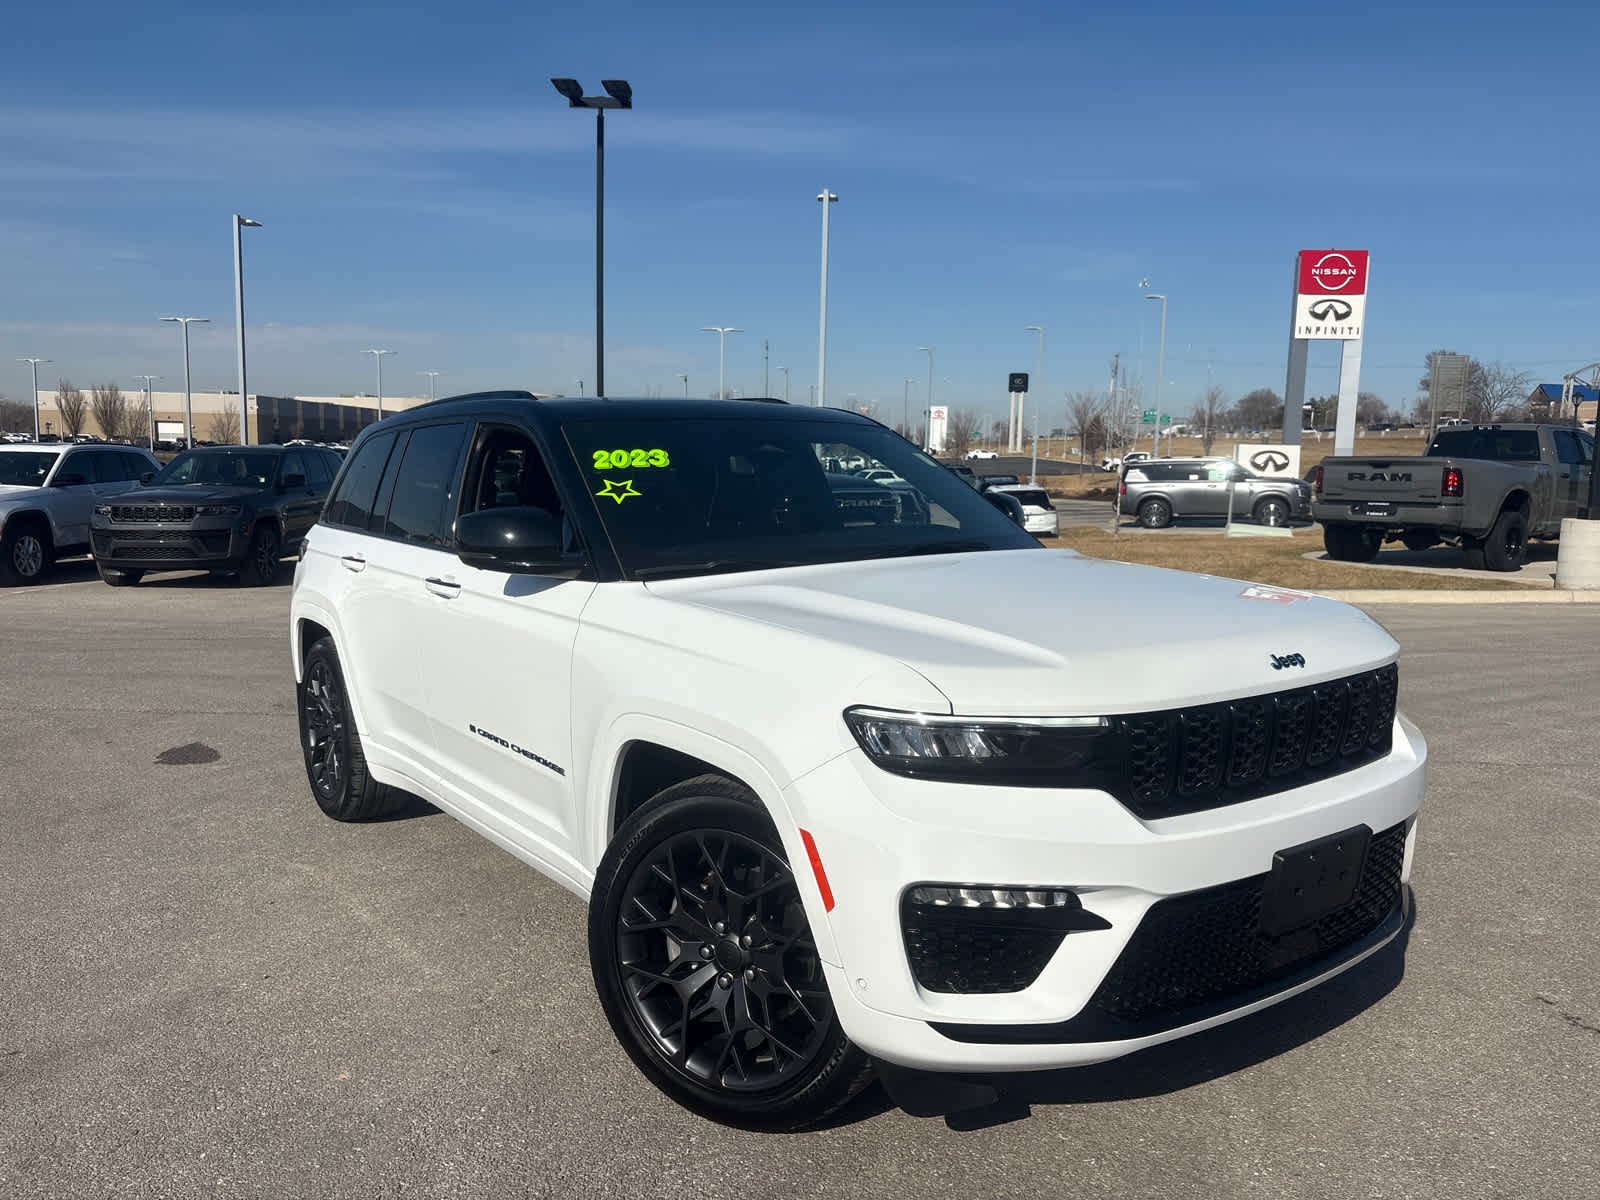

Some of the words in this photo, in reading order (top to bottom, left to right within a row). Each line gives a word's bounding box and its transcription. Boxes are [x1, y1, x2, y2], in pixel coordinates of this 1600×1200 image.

[1311, 268, 1357, 276] NISSAN
[1298, 326, 1360, 335] INFINITI
[592, 448, 670, 470] 2023
[1347, 472, 1413, 482] RAM
[1270, 652, 1306, 670] Jeep
[477, 727, 510, 749] GRAND
[511, 743, 566, 777] CHEROKEE
